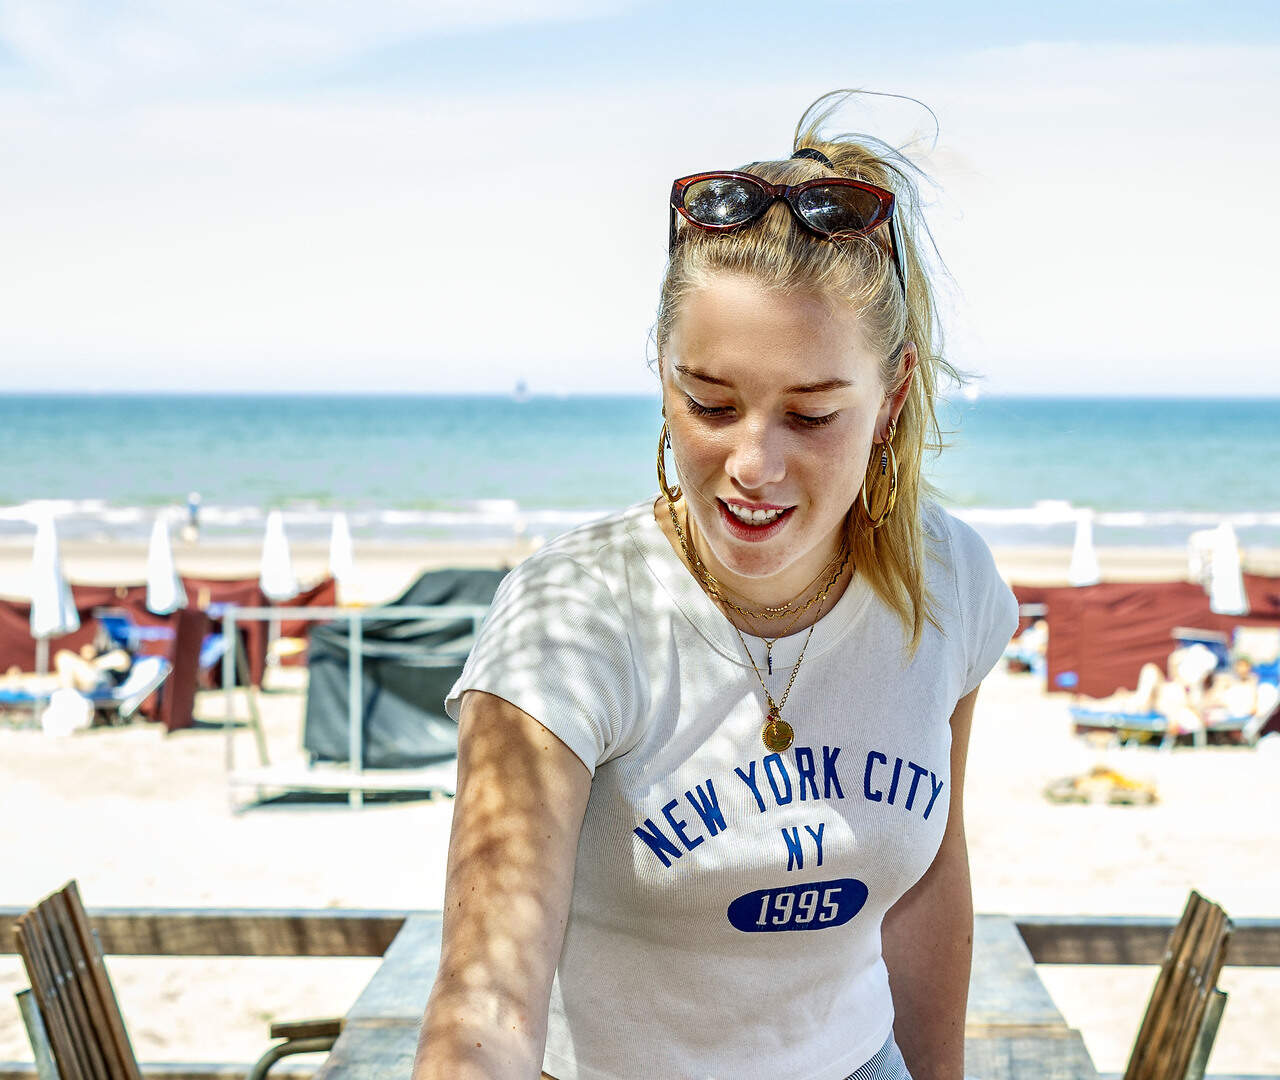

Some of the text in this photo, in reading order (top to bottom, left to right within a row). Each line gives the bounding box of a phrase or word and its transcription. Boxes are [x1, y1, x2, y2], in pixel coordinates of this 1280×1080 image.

[634, 746, 944, 868] NEW YORK CITY
[781, 823, 825, 871] NY
[755, 887, 843, 926] 1995
